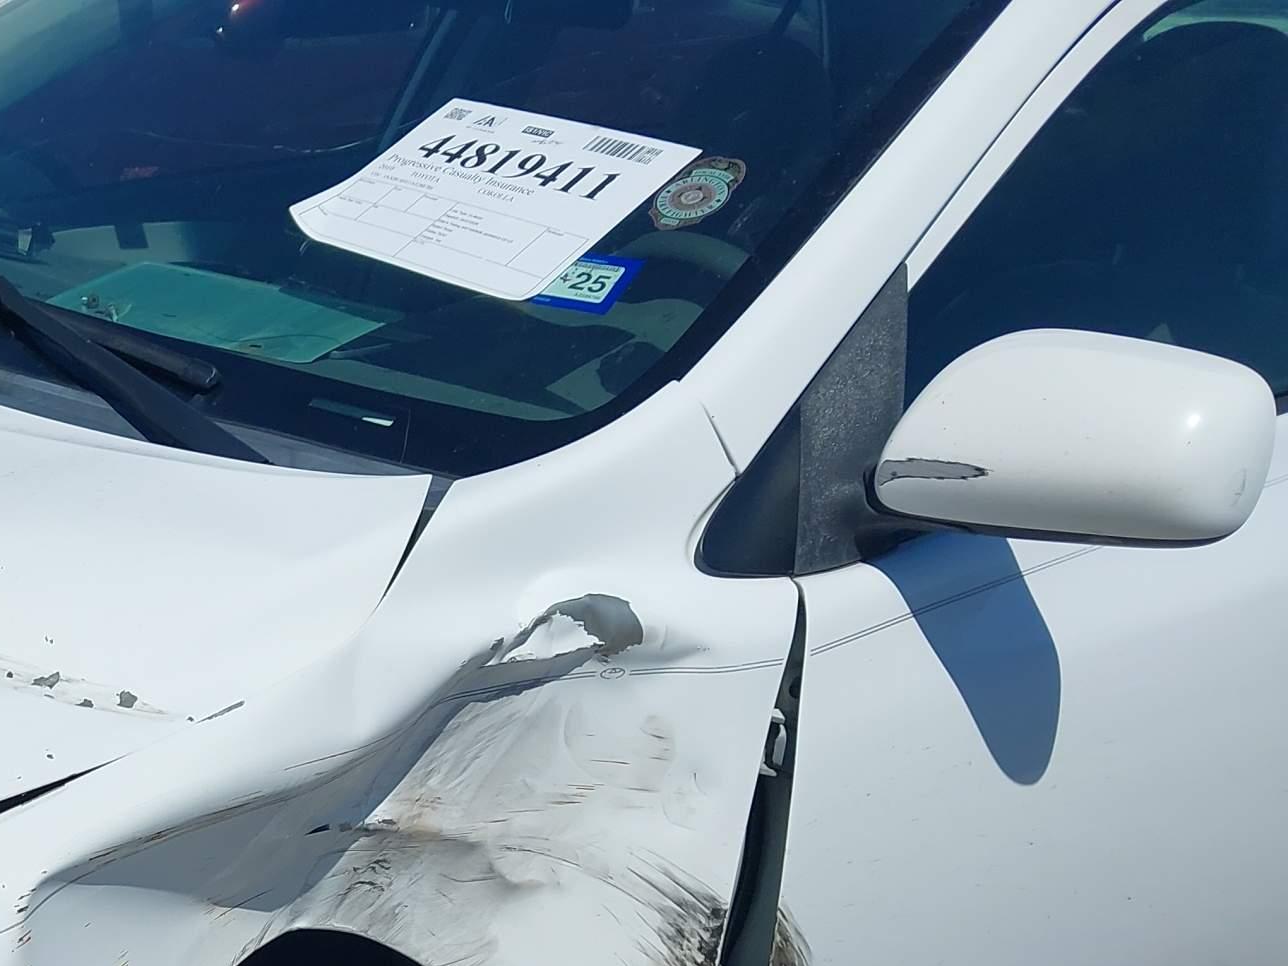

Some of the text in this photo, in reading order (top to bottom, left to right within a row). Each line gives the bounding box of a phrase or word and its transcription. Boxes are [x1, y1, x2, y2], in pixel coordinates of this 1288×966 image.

[387, 153, 442, 173] Progressive
[443, 165, 485, 184] Casualty
[486, 176, 535, 196] Insurance
[419, 134, 621, 201] 44819411
[567, 271, 611, 293] 25
